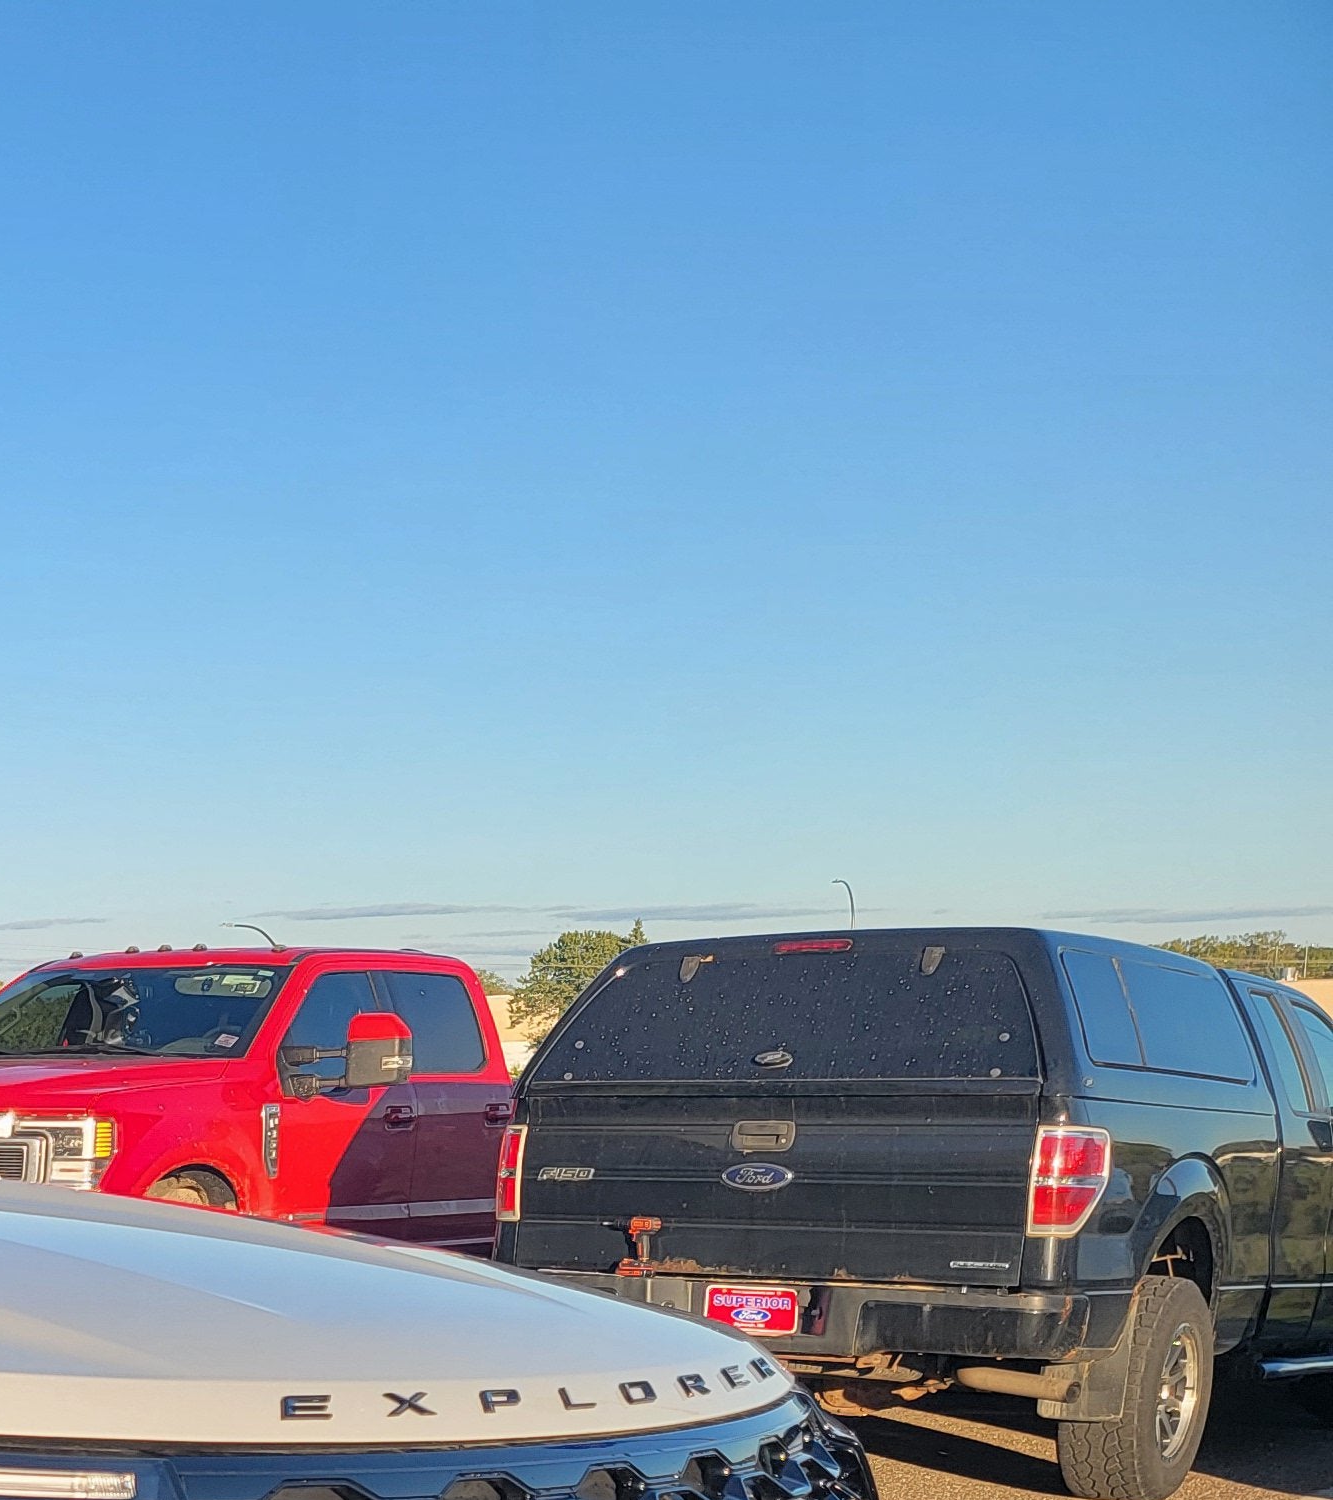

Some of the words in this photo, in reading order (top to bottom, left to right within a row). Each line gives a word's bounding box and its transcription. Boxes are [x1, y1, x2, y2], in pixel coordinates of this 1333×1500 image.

[536, 1166, 595, 1181] F-150
[734, 1167, 775, 1184] Ford
[713, 1293, 792, 1311] SUPERIOR
[738, 1310, 764, 1321] Ford
[279, 1356, 776, 1421] EXPLORER
